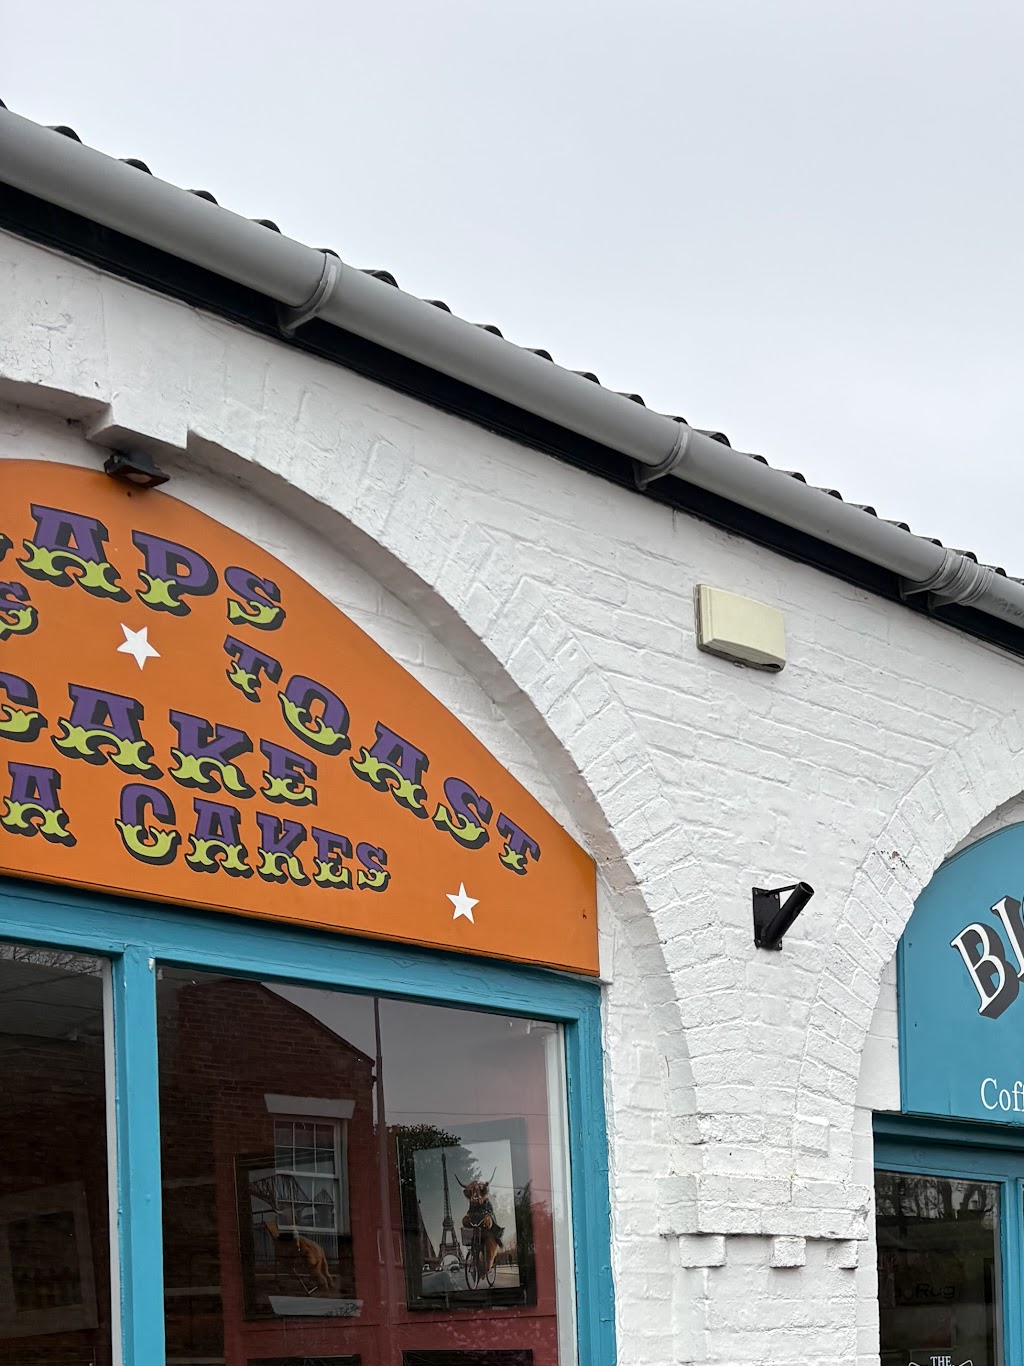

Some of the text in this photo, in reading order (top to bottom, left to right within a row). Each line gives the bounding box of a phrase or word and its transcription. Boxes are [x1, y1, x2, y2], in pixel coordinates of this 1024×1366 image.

[0, 503, 285, 631] APS
[0, 580, 540, 876] S TOAST
[0, 761, 390, 892] A CAKES
